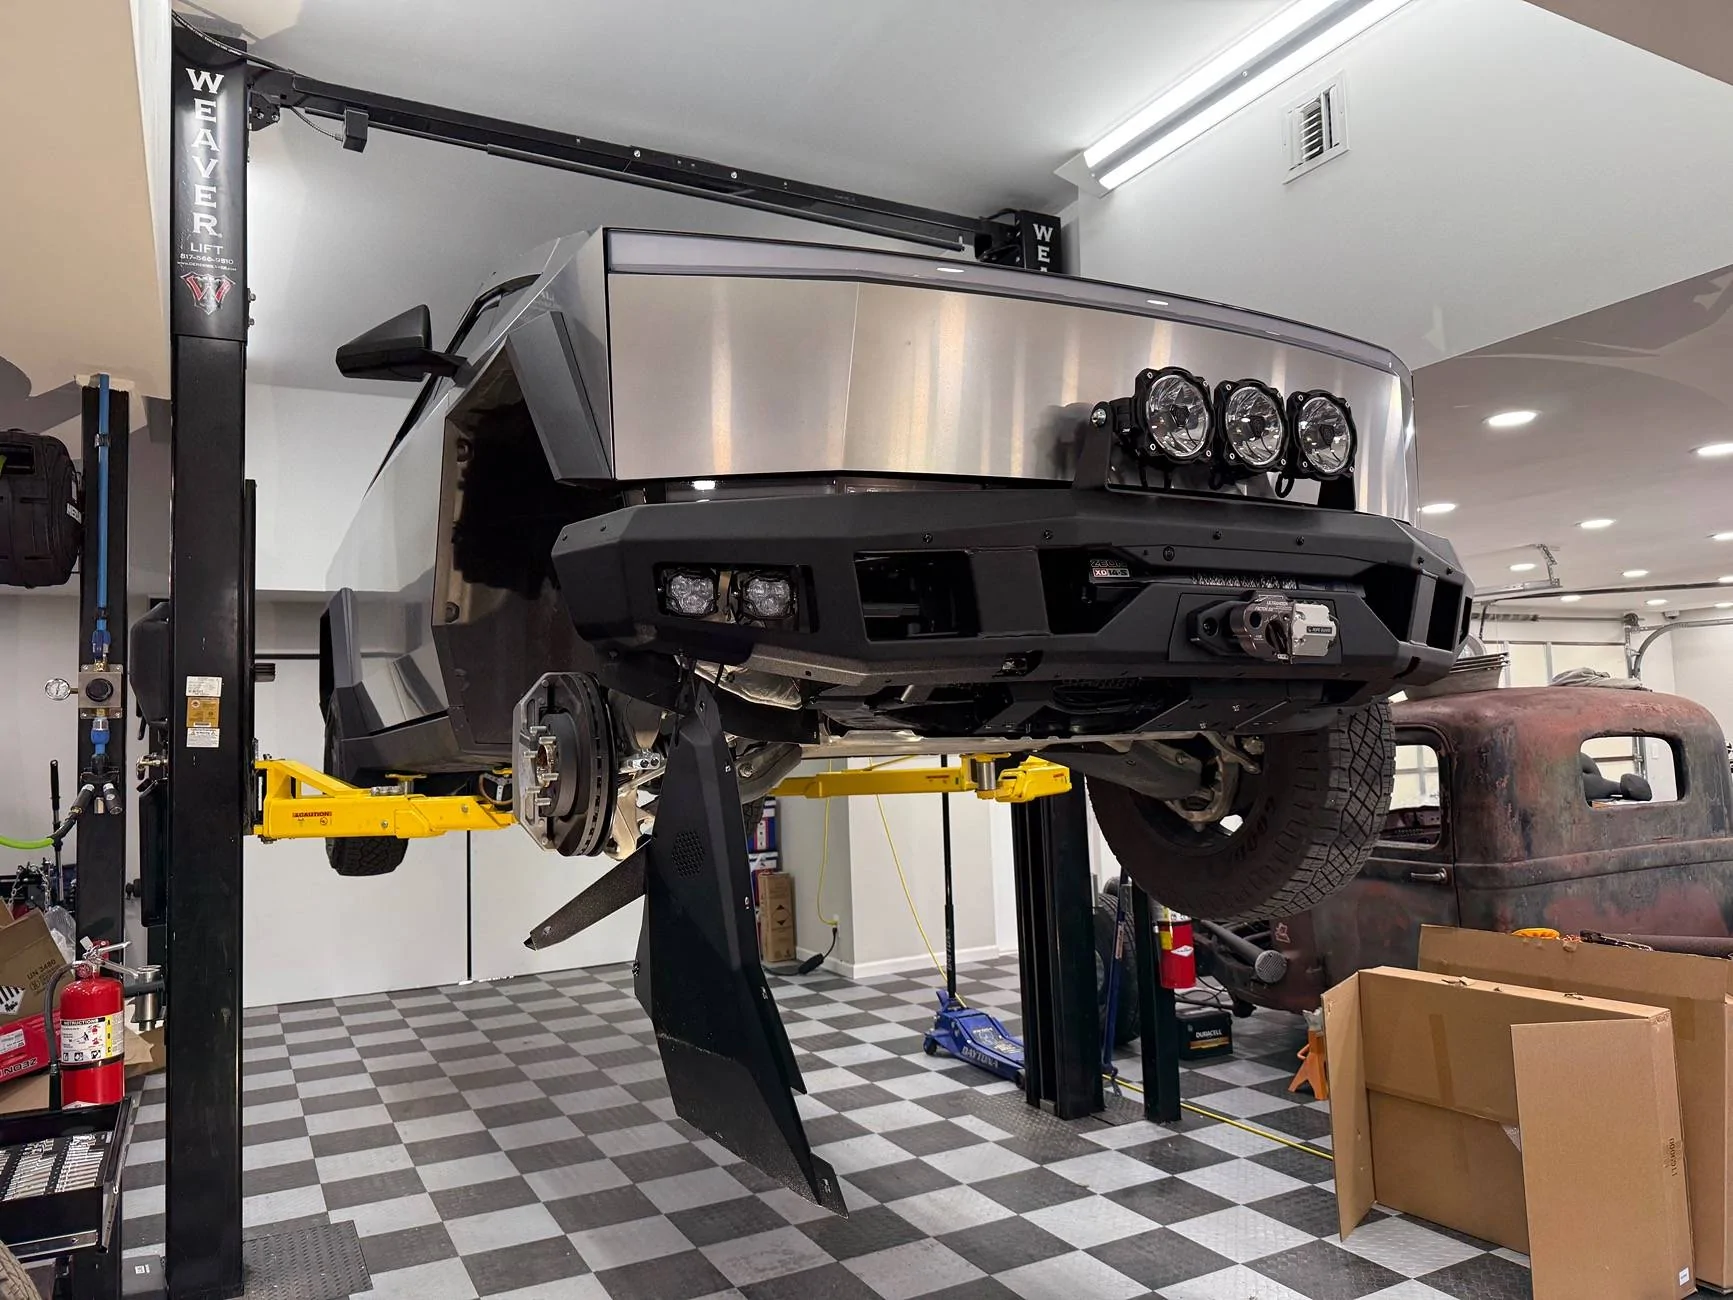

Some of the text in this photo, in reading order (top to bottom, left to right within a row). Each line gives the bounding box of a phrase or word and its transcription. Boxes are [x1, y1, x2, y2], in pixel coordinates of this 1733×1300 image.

[186, 68, 225, 237] WEAVER
[190, 242, 223, 254] LIFT
[1195, 1028, 1223, 1039] DURACELL
[962, 1046, 999, 1069] DAYTONA
